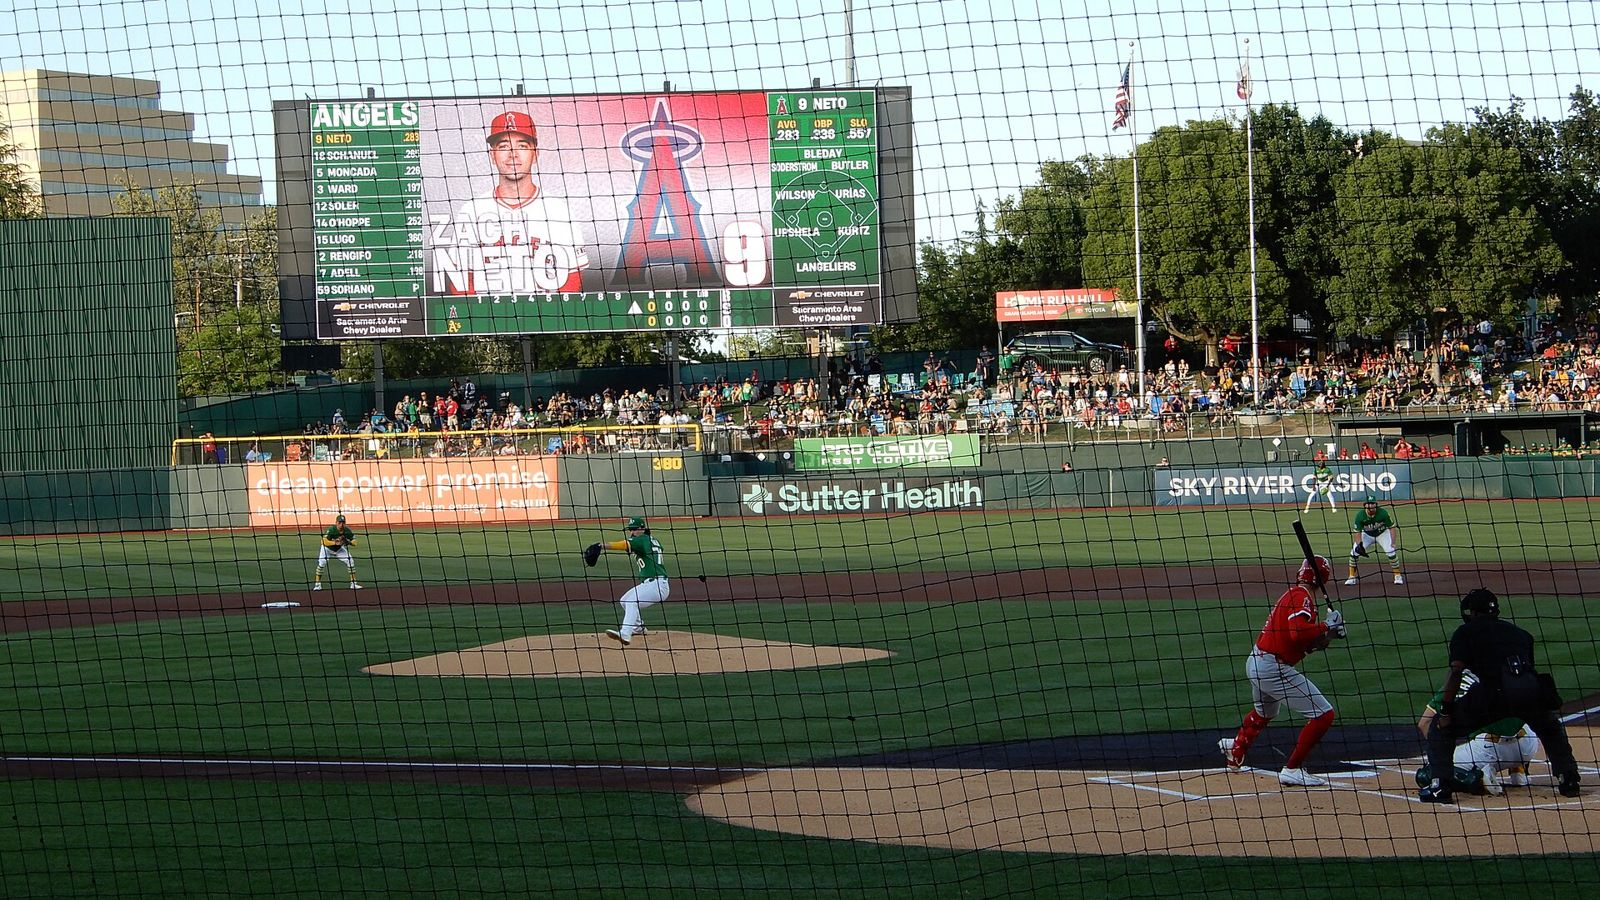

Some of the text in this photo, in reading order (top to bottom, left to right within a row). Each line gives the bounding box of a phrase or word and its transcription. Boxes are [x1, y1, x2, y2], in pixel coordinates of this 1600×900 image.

[798, 97, 807, 110] 9
[813, 96, 847, 110] NETO
[313, 102, 418, 128] ANGELS
[814, 118, 833, 128] OBP
[315, 134, 323, 144] 9
[326, 134, 352, 144] NETO
[327, 150, 379, 160] SCHANUEL
[803, 148, 842, 159] BLEDAY
[771, 160, 869, 172] SODERSTROM BUTLER
[316, 170, 324, 178] 5
[327, 167, 378, 177] MONCADA
[316, 182, 420, 194] 3 WARD .197
[775, 189, 815, 200] WILSON
[316, 201, 328, 211] 12
[328, 201, 360, 211] SOLER
[316, 218, 328, 228] 14
[329, 218, 371, 228] O'HOPPE
[429, 211, 529, 246] ZACH
[837, 225, 870, 236] KURTZ
[317, 235, 329, 245] 15
[330, 234, 356, 244] LUGO
[319, 252, 327, 262] 2
[330, 251, 372, 261] RENGIFO
[723, 220, 768, 287] 9
[432, 246, 570, 293] NETO
[796, 261, 857, 273] LANGELIERS
[319, 268, 327, 278] 7
[330, 268, 362, 278] ADELL
[316, 283, 420, 295] 59 SORIANO P
[814, 290, 865, 298] CHEVROLET
[477, 295, 482, 304] 1
[494, 295, 500, 303] 2
[511, 295, 518, 303] 3
[528, 294, 535, 303] 4
[545, 294, 552, 302] 5
[563, 293, 570, 302] 6
[580, 292, 587, 301] 7
[597, 292, 604, 301] 8
[615, 291, 622, 300] 9
[1047, 295, 1075, 306] RUN
[1077, 293, 1105, 305] HILL
[358, 302, 410, 310] CHEVROLET
[647, 300, 656, 312] 0
[665, 300, 673, 311] 0
[682, 299, 690, 311] 0
[699, 299, 708, 310] 0
[792, 304, 863, 314] Sacramento Area
[336, 316, 387, 326] Sacramento
[648, 315, 657, 327] 0
[665, 315, 673, 327] 0
[682, 315, 691, 326] 0
[699, 314, 708, 325] 0
[798, 313, 856, 323] Chevy Dealers
[342, 326, 402, 336] Chevy Dealers
[653, 457, 683, 471] 380
[821, 457, 863, 466] PEST
[256, 464, 549, 501] clean power promise
[1168, 477, 1218, 497] SKY
[1223, 474, 1295, 496] RIVER
[778, 480, 983, 512] Sutter Health
